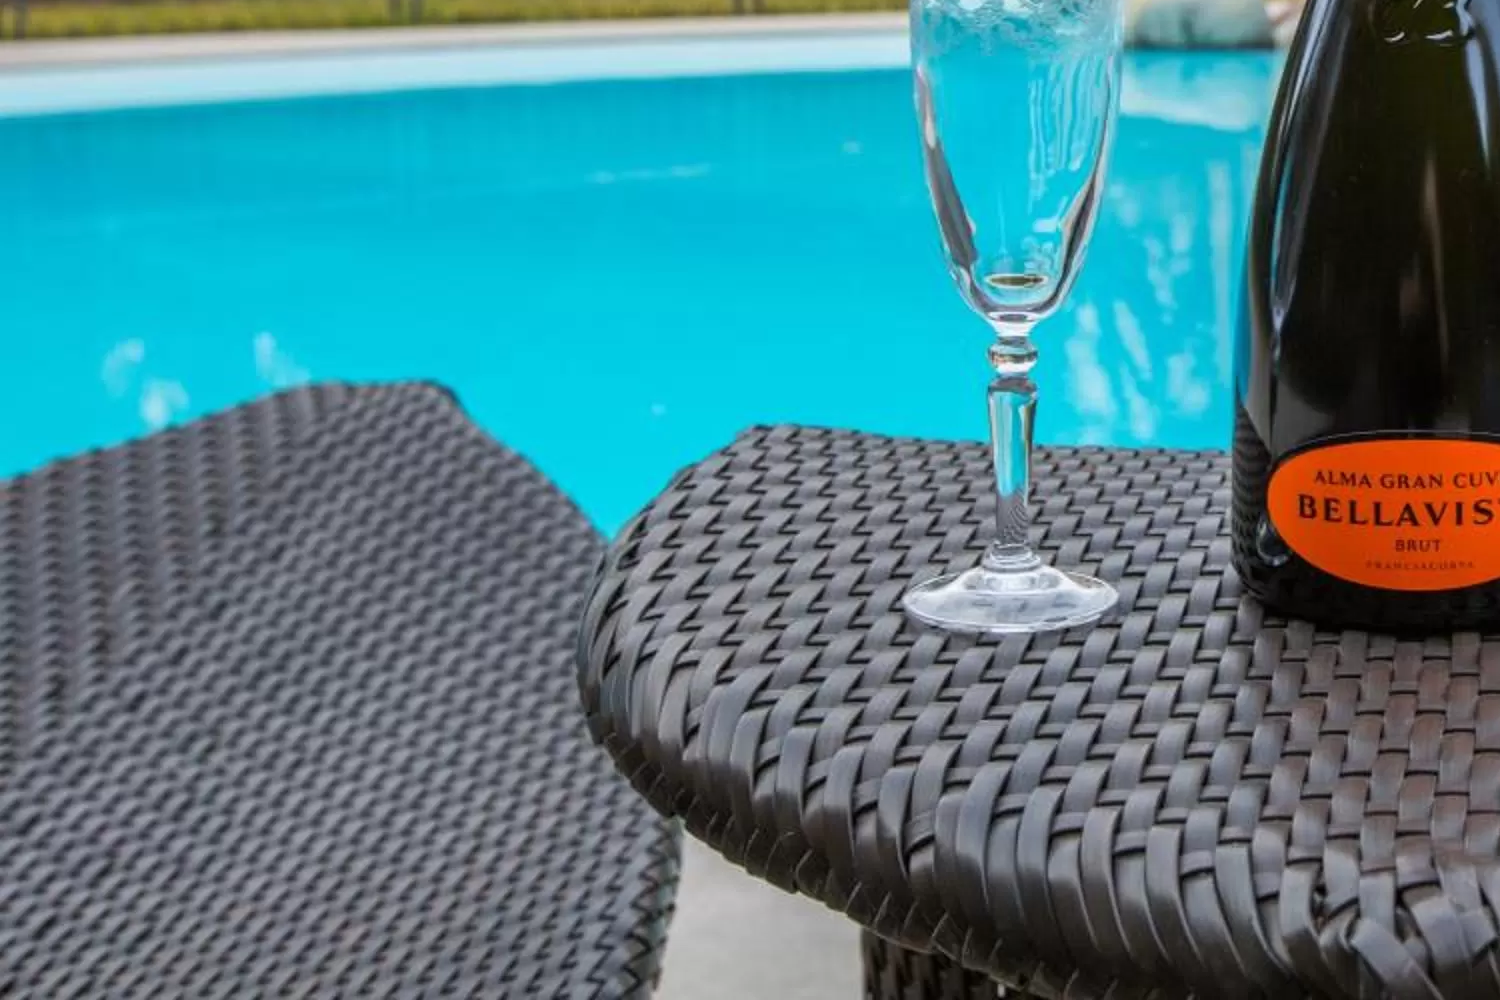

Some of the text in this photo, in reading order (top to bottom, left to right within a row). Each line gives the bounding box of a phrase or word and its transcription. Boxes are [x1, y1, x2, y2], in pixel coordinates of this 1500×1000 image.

[1315, 469, 1372, 489] ALMA
[1380, 474, 1443, 489] GRAN
[1394, 538, 1442, 552] BRUT
